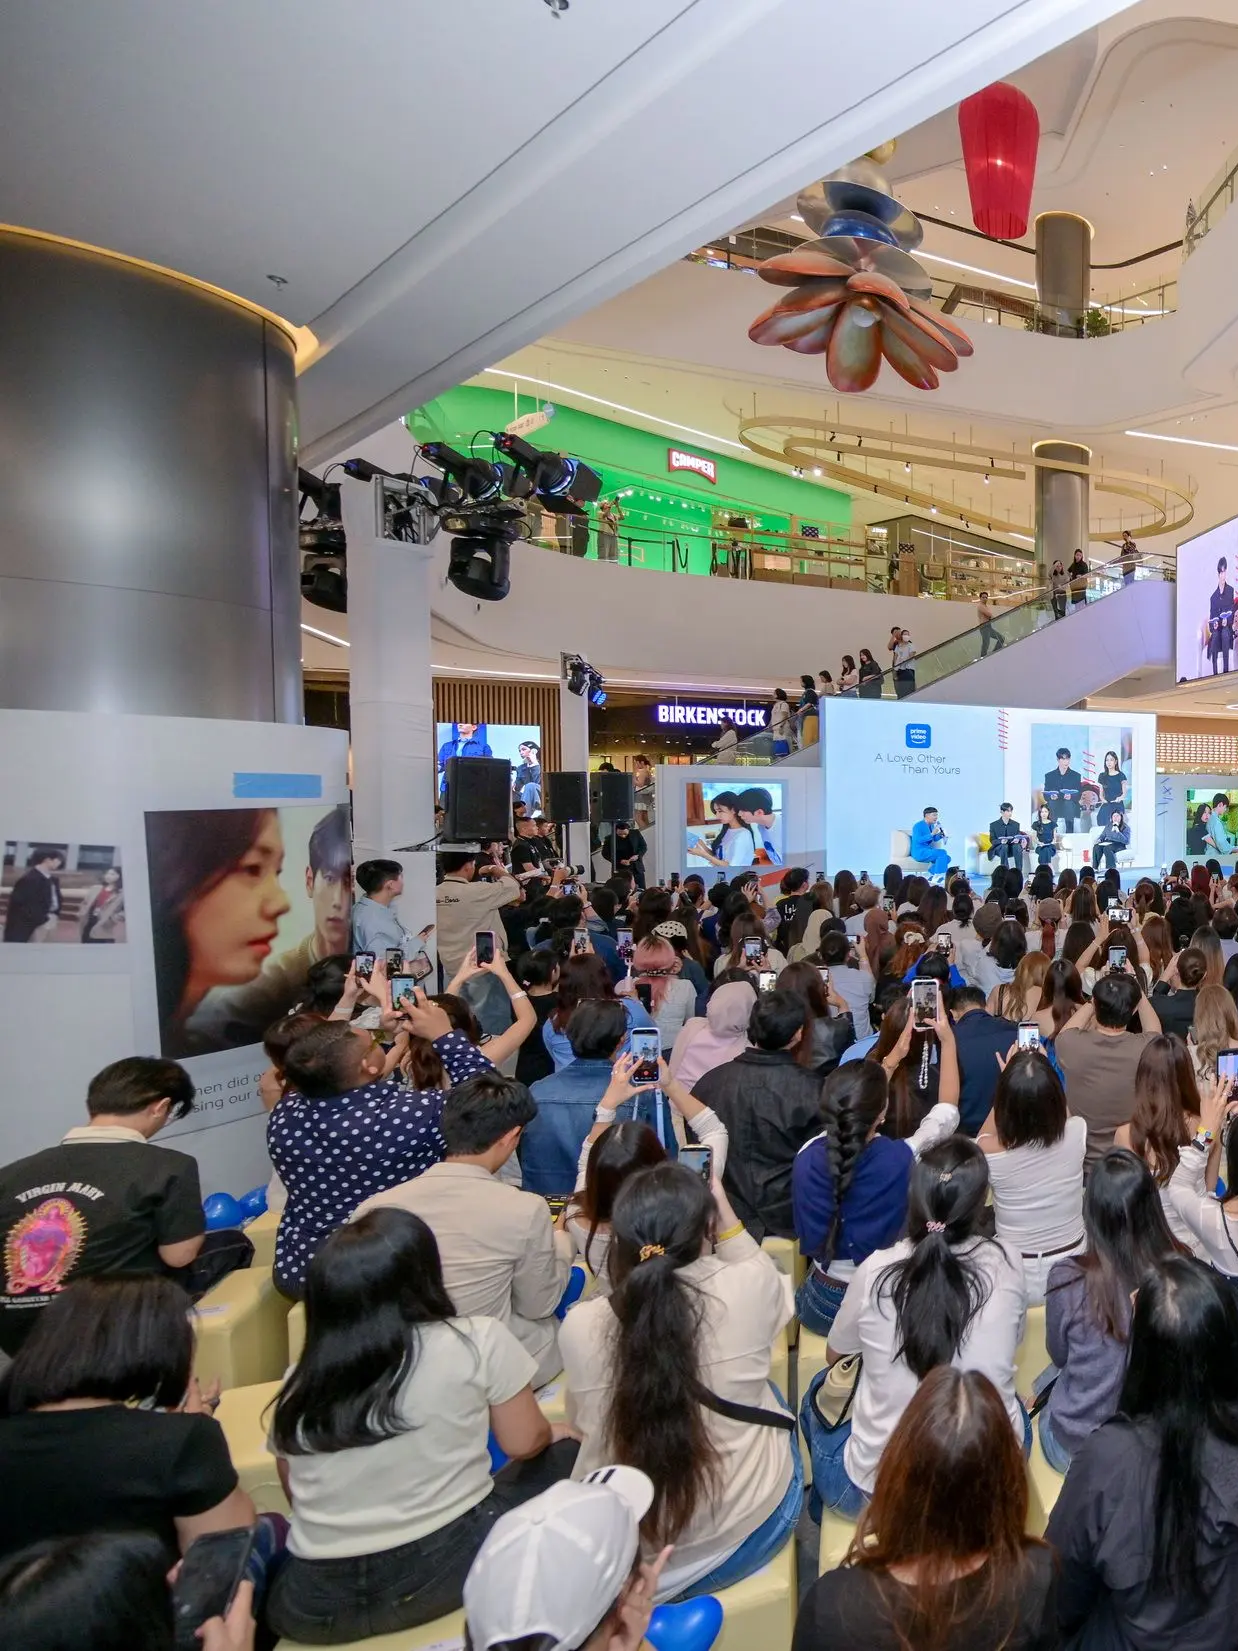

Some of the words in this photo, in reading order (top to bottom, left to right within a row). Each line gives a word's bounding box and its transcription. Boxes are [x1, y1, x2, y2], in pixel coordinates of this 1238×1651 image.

[671, 451, 715, 478] CAMPER
[658, 705, 766, 727] BIRKENSTOCK
[910, 728, 927, 736] prime
[875, 753, 883, 763] A
[886, 753, 913, 763] Love
[917, 753, 946, 764] Other
[901, 764, 929, 775] Than
[932, 765, 961, 775] Yours
[227, 1074, 249, 1089] did
[228, 1092, 251, 1104] our
[14, 1182, 67, 1203] VIRGIN
[66, 1182, 105, 1201] MARY
